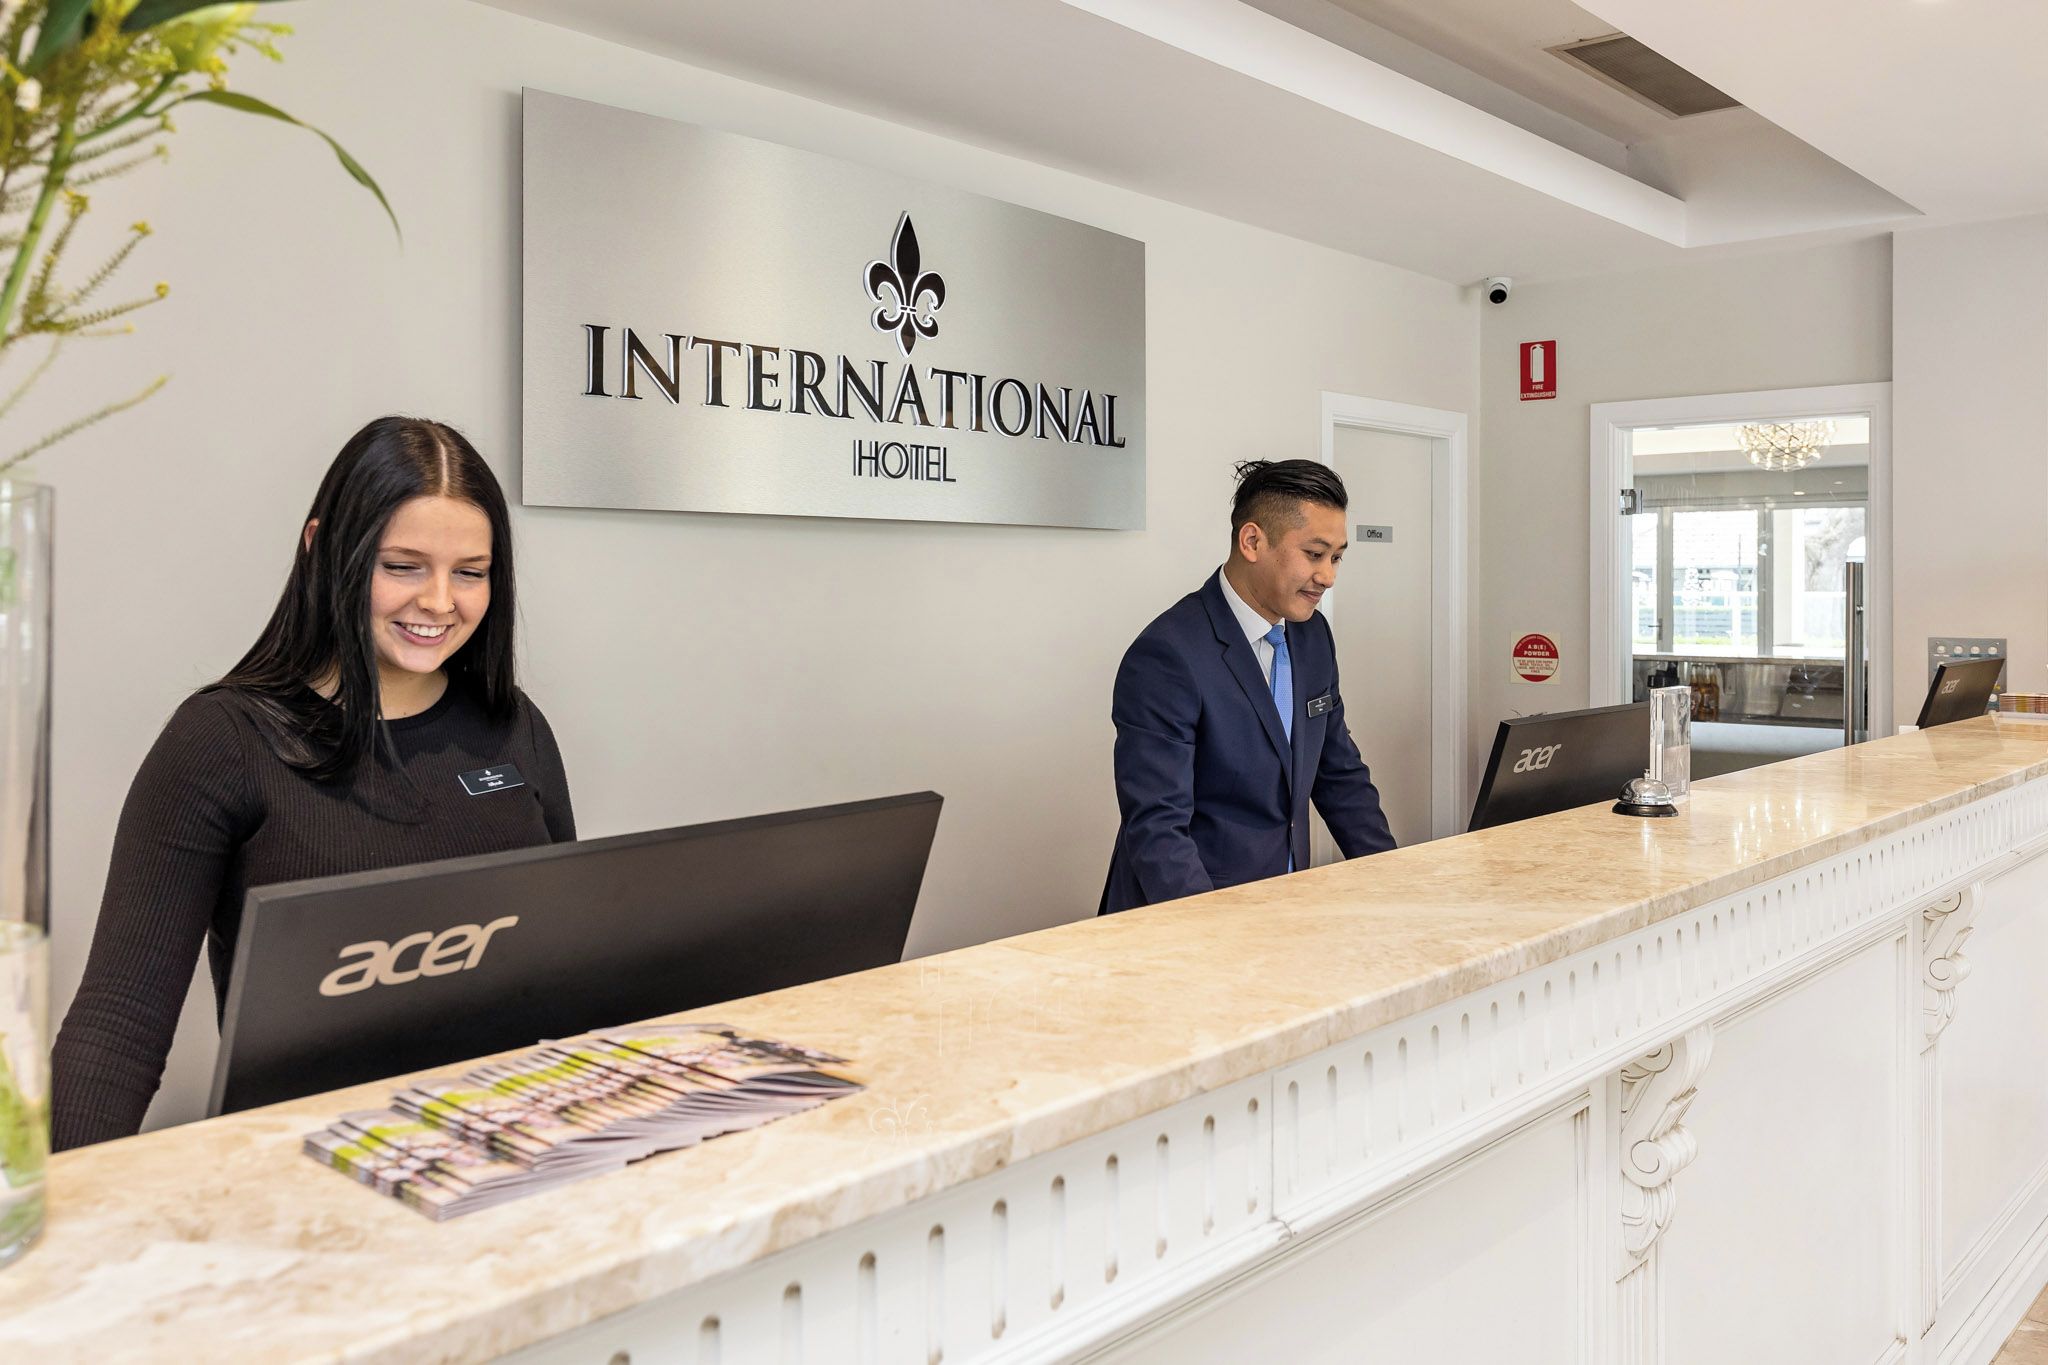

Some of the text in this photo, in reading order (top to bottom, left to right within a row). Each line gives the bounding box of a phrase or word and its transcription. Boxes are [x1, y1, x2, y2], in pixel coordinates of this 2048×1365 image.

[582, 323, 1126, 448] INTERNATIONAL
[1520, 391, 1556, 399] EXTINGUISHER
[1532, 383, 1544, 391] FIRE
[853, 439, 957, 482] HOTEL
[1513, 743, 1562, 773] acer
[319, 915, 520, 997] acer
